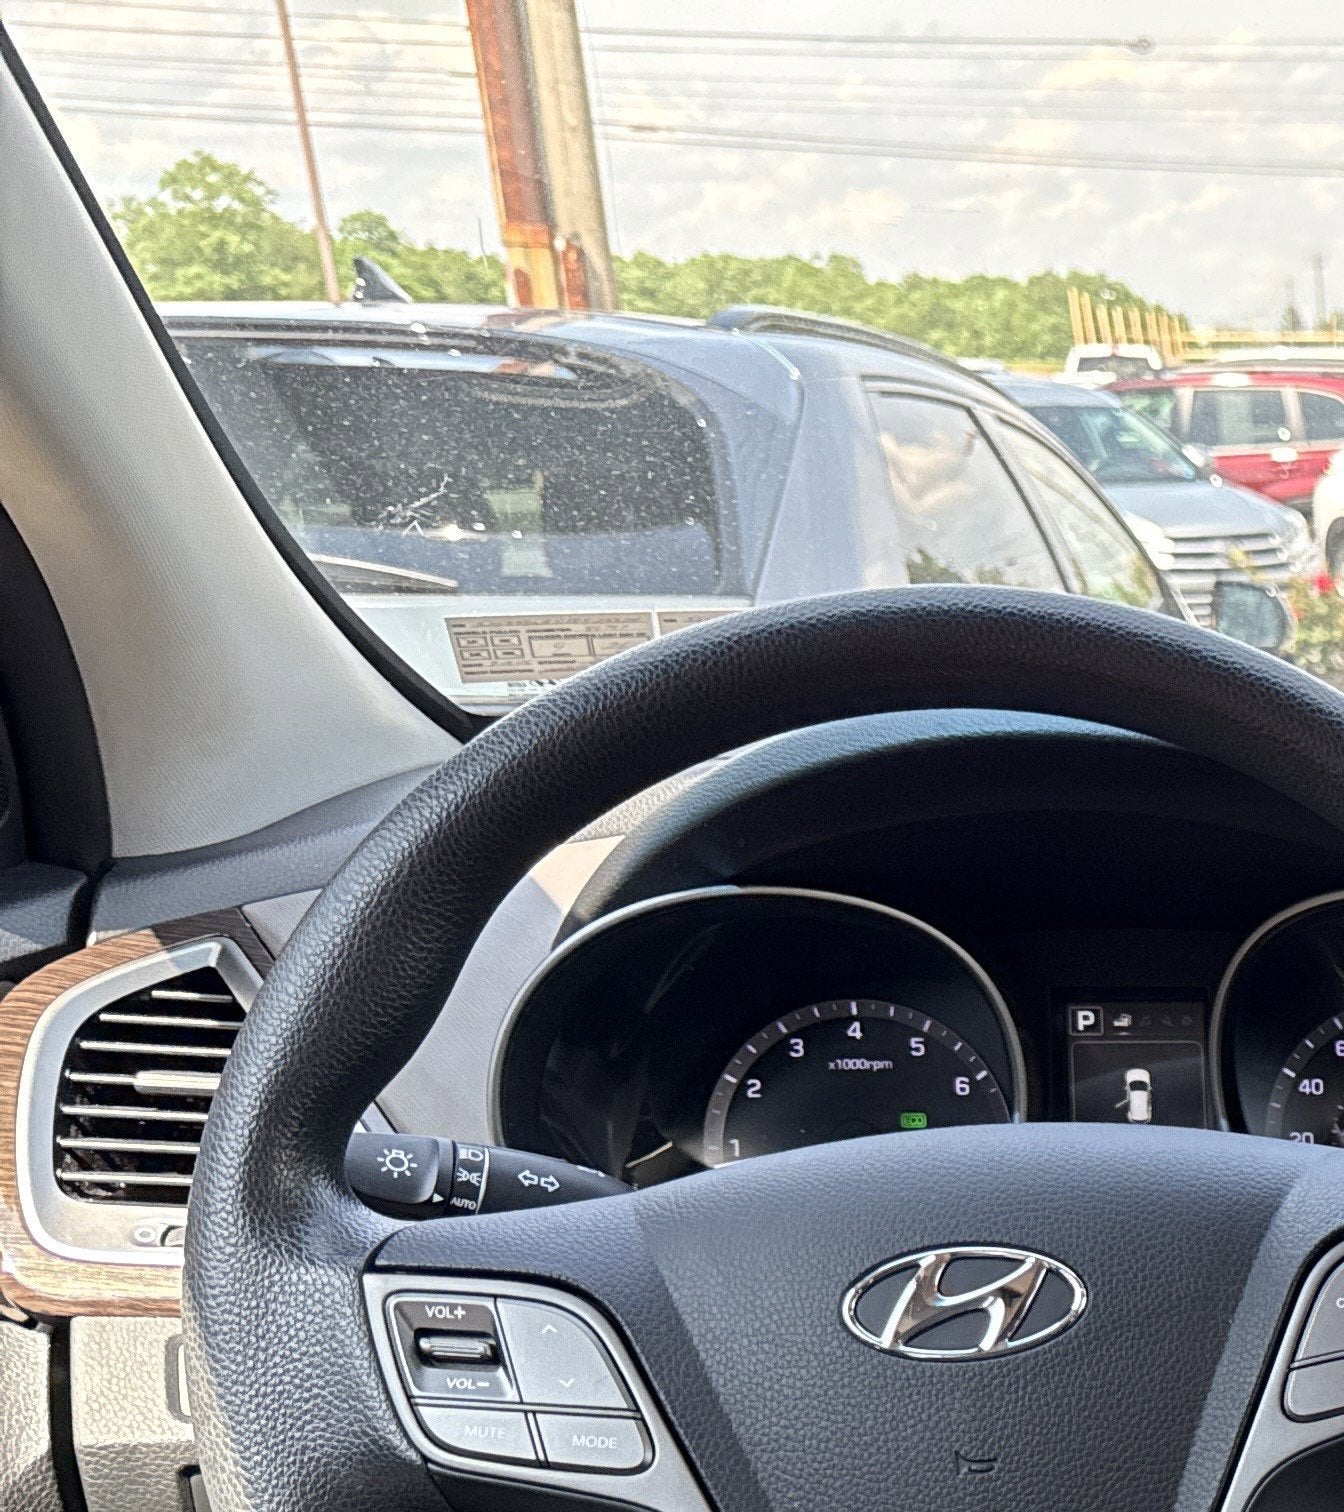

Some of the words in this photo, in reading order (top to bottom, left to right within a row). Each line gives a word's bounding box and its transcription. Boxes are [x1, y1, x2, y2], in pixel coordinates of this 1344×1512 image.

[1075, 1009, 1096, 1032] P
[846, 1021, 863, 1041] 4
[789, 1038, 805, 1058] 3
[909, 1037, 926, 1057] 5
[828, 1058, 893, 1072] x1000rpm
[746, 1079, 762, 1099] 2
[954, 1076, 971, 1097] 6
[1298, 1078, 1324, 1095] 40
[730, 1138, 740, 1157] 1
[1289, 1132, 1314, 1145] 20
[450, 1196, 477, 1211] AUTO
[464, 1423, 506, 1440] MUTE
[571, 1434, 618, 1450] MODE
